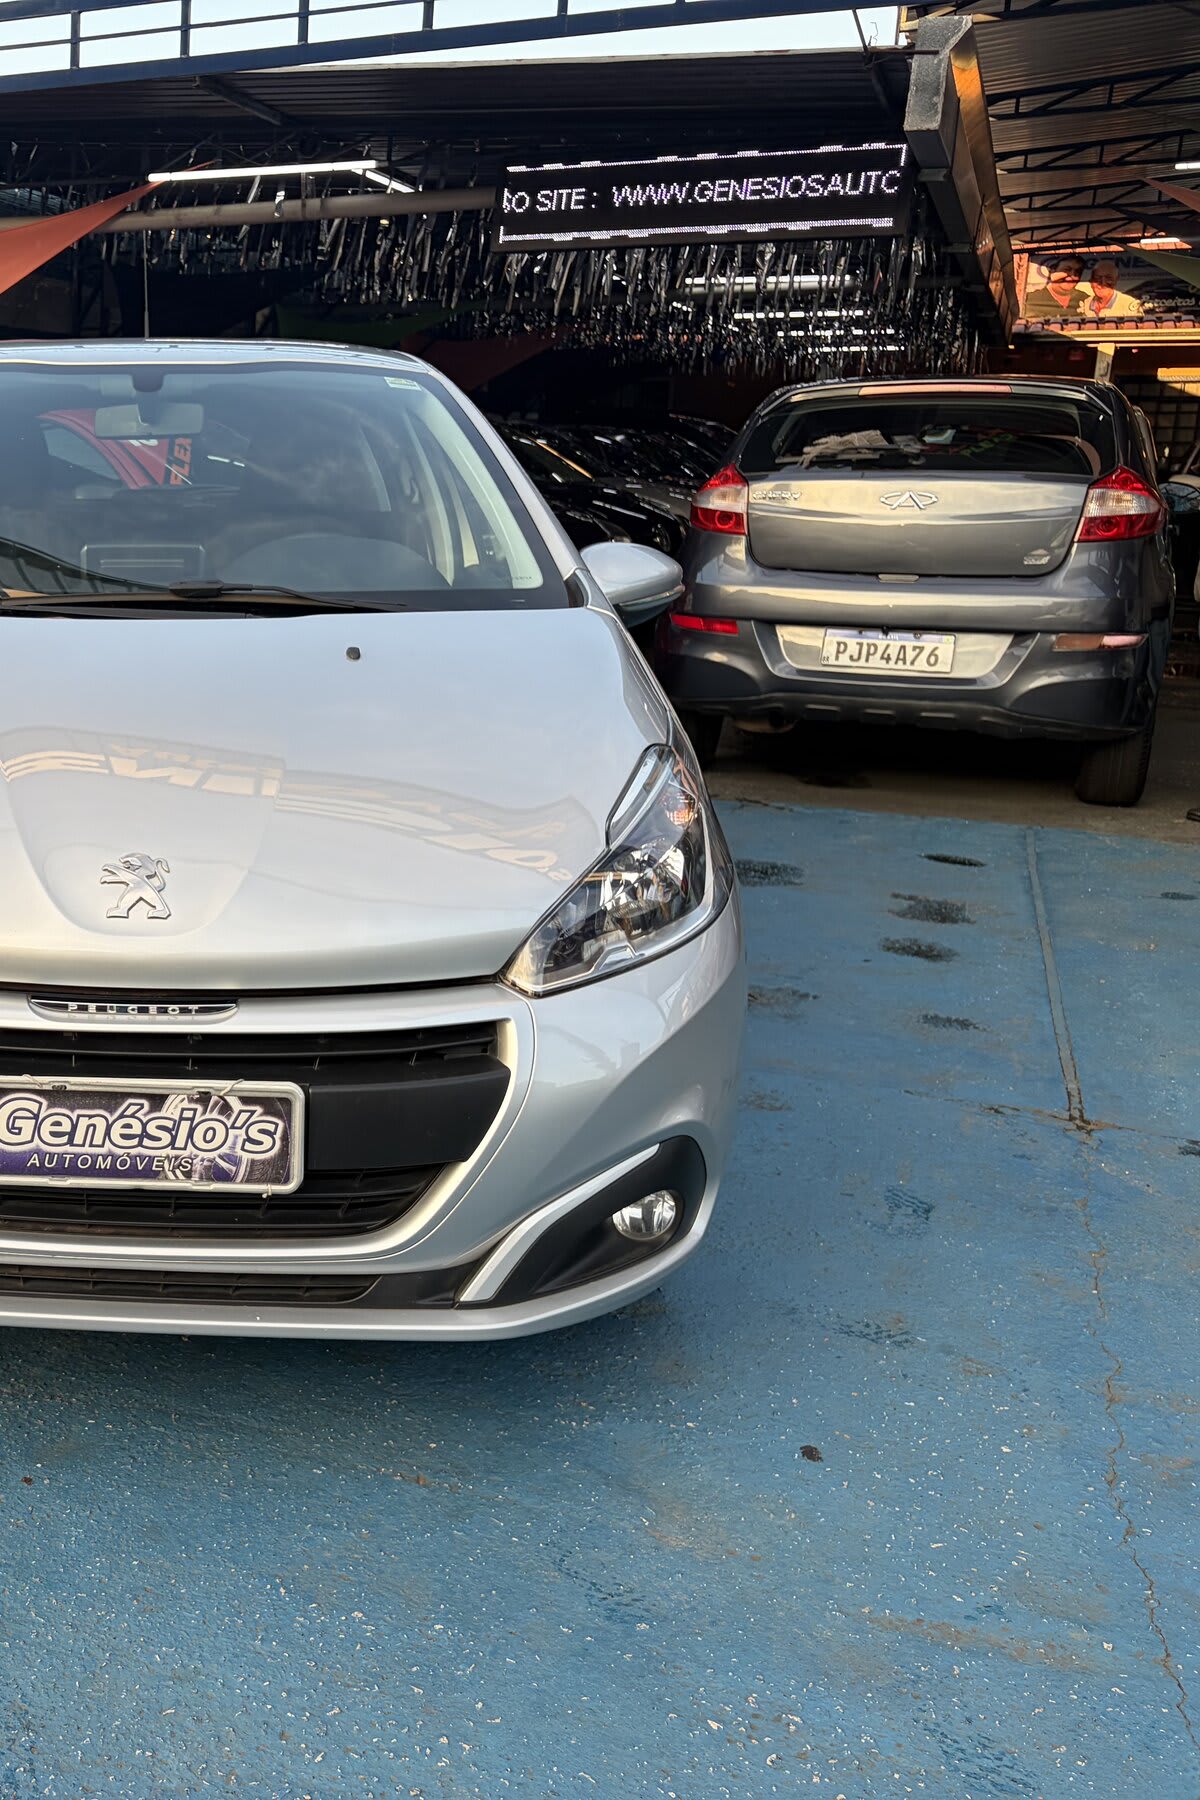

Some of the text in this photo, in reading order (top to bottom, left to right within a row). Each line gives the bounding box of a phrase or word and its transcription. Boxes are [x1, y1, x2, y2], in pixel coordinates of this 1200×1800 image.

[834, 640, 940, 667] PJP4A76
[67, 1003, 198, 1015] PEUGEOT
[27, 1152, 193, 1171] AUTOMÓVEIS
